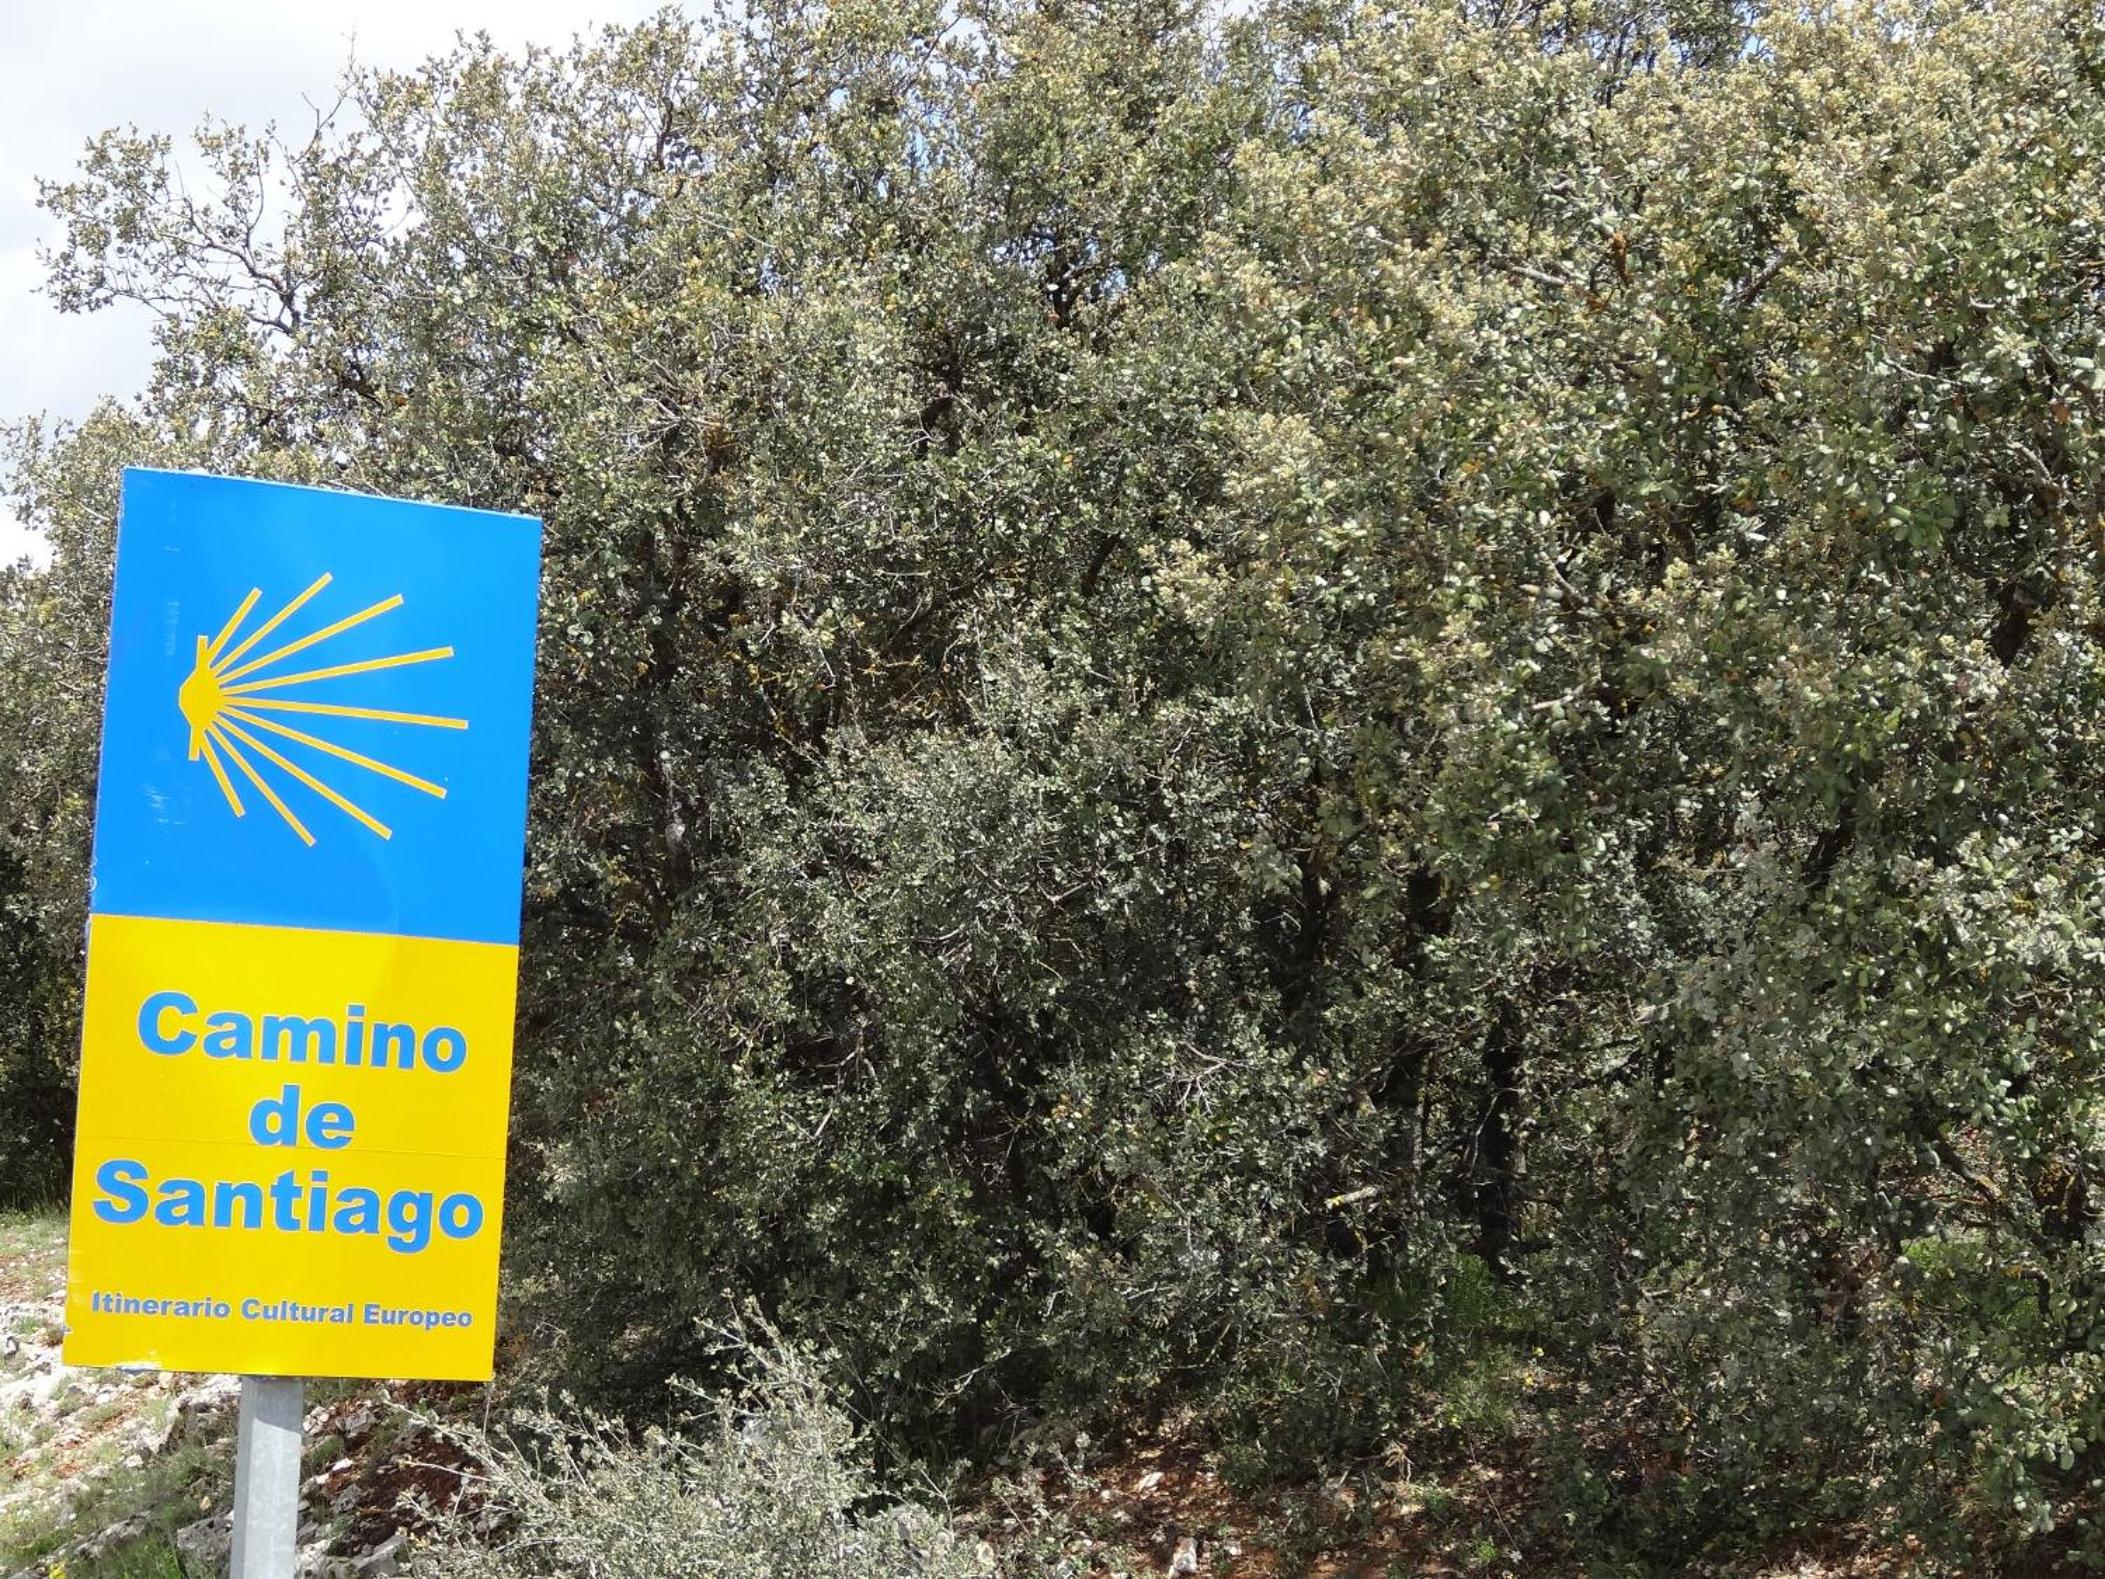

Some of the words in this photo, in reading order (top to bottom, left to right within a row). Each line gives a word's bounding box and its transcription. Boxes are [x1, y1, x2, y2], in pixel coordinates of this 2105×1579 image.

[138, 991, 467, 1072] Camino
[249, 1084, 355, 1149] de
[93, 1159, 484, 1254] Santiago
[91, 1291, 230, 1319] Itinerario
[241, 1298, 354, 1324] Cultural
[363, 1304, 473, 1329] Europeo
